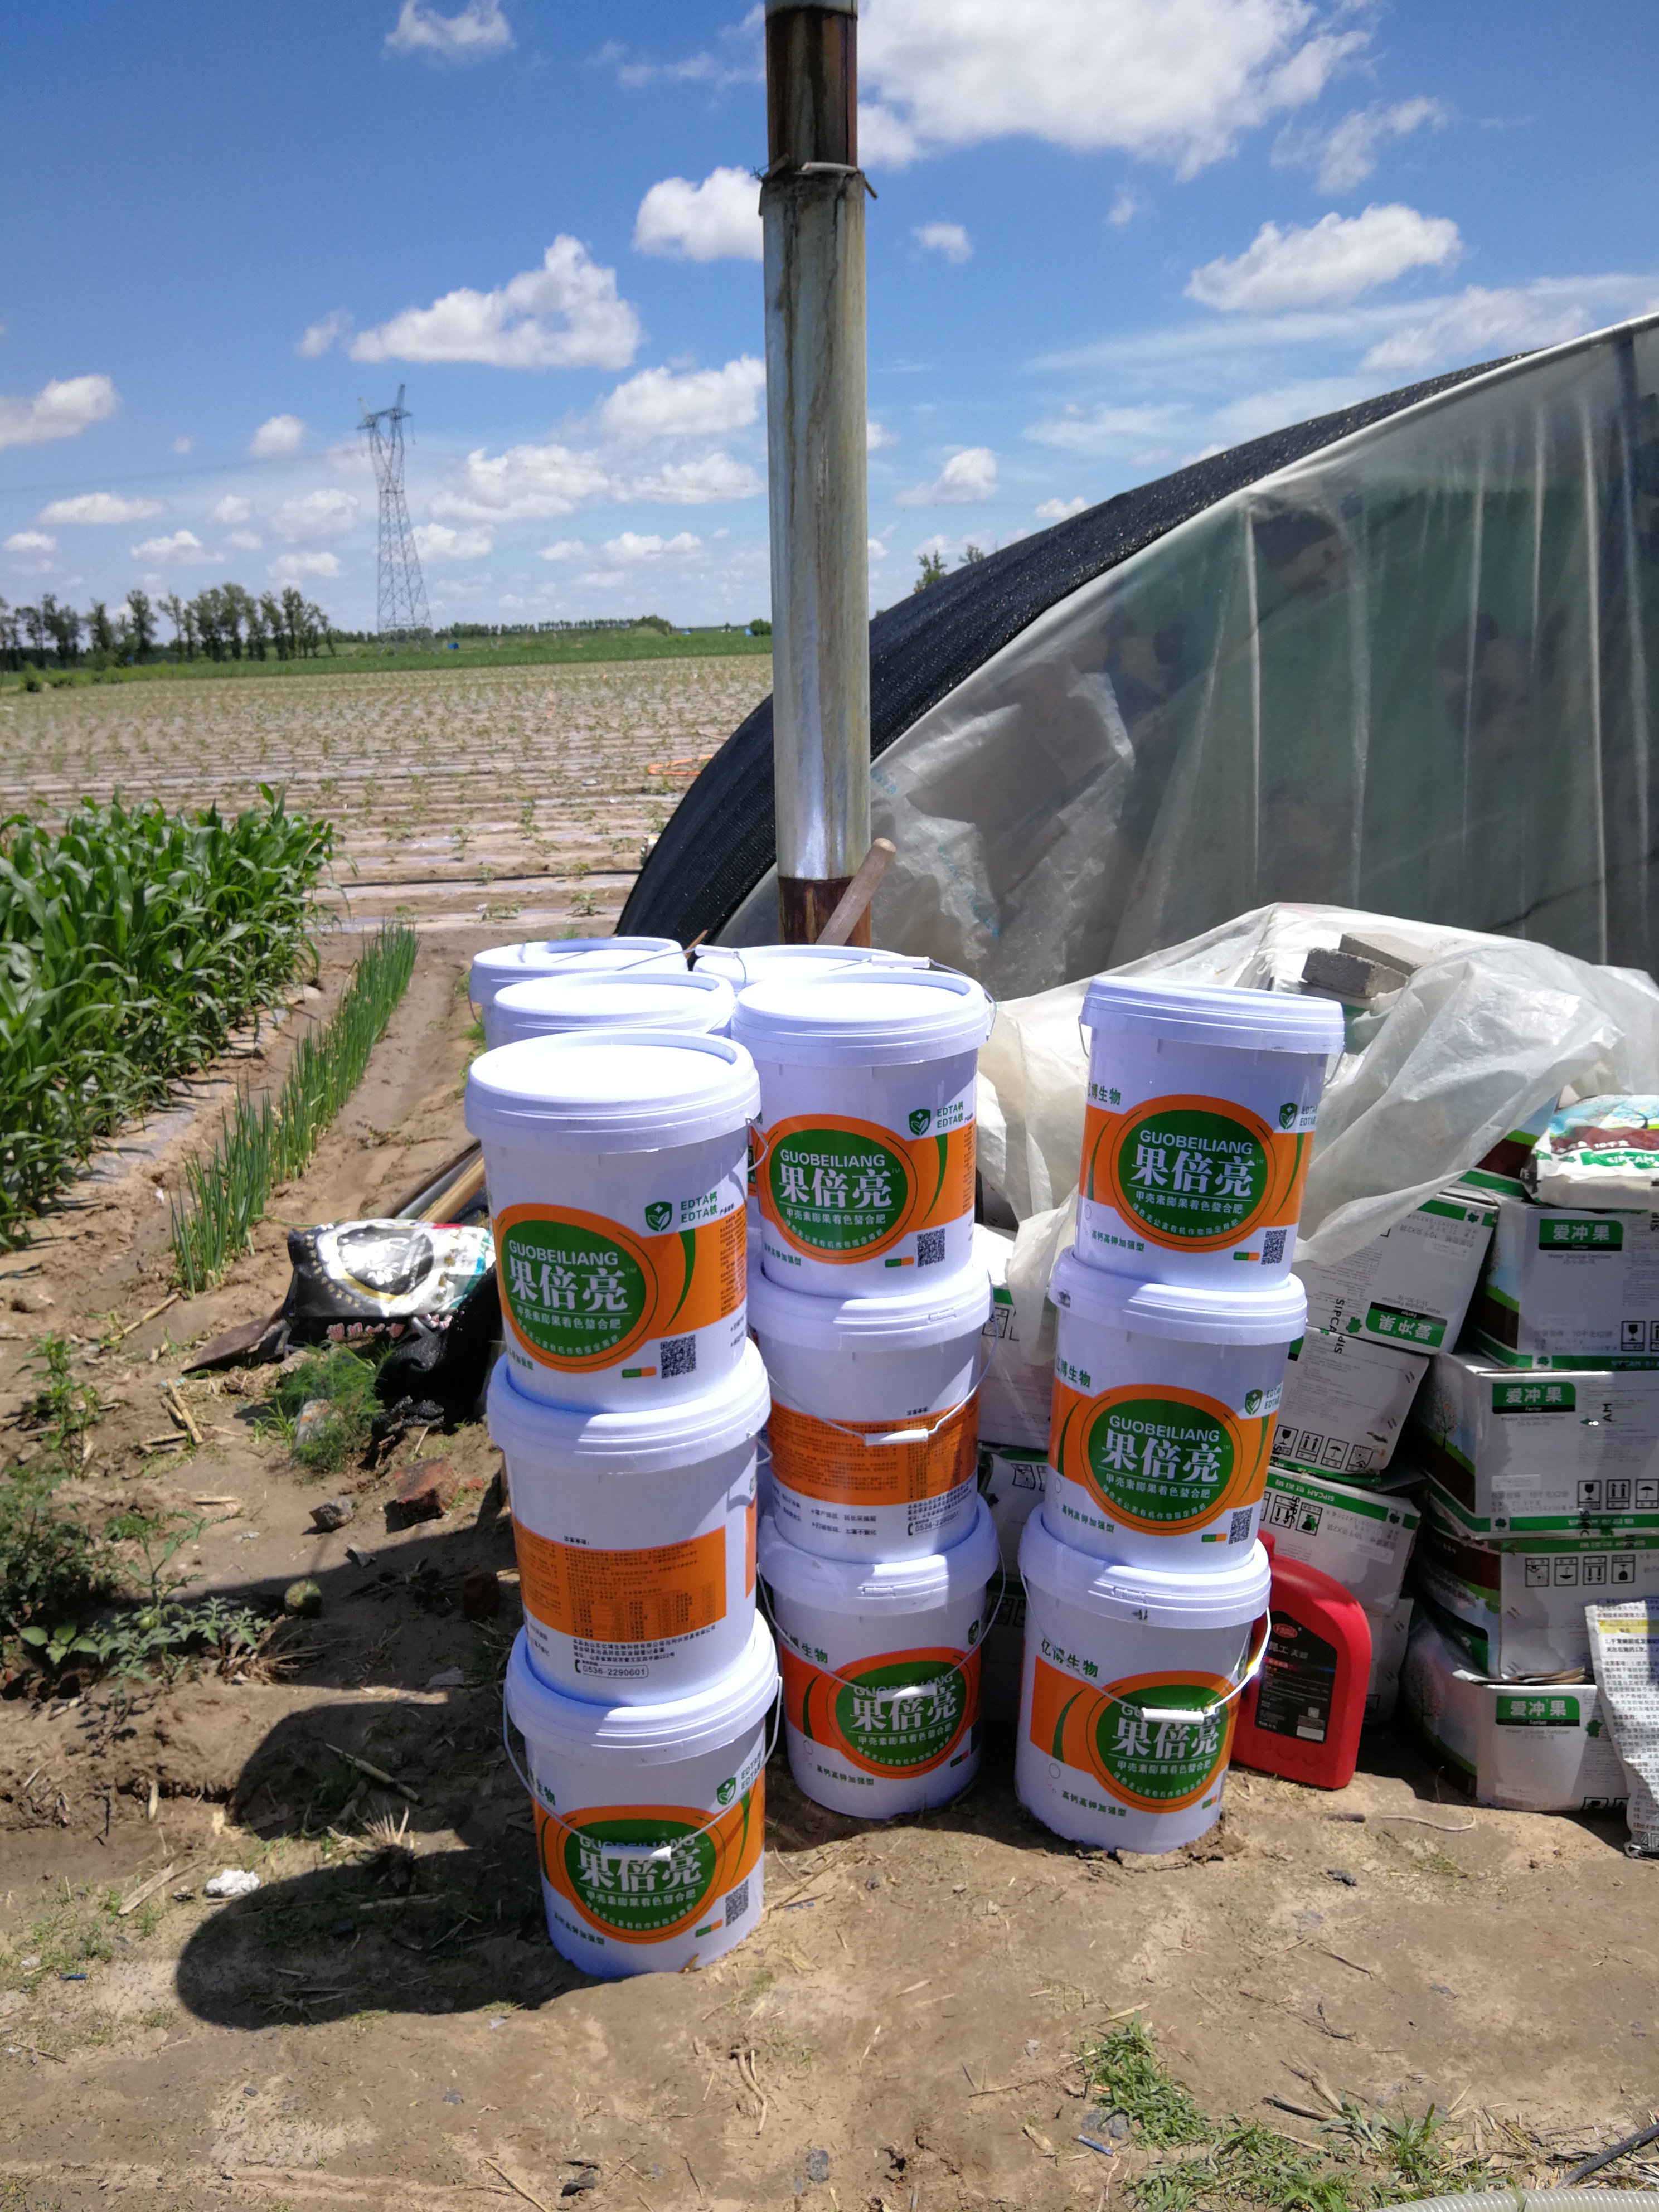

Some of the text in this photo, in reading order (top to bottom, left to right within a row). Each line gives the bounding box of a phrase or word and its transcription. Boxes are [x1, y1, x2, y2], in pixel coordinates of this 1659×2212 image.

[1139, 1129, 1254, 1154] GUOBEILIANG
[780, 1148, 885, 1167] GUOBEILIANG
[1130, 1143, 1256, 1197] 果倍亮
[779, 1162, 892, 1210] 果倍亮
[1553, 1224, 1610, 1241] 爱冲果
[508, 1239, 618, 1265] GUOBEILIANG
[508, 1255, 628, 1312] 果倍亮
[1377, 1313, 1432, 1342] 爱冲果
[1506, 1386, 1563, 1404] 爱冲果
[1109, 1414, 1220, 1443] GUOBEILIANG
[1100, 1428, 1223, 1482] 果倍亮
[849, 1684, 957, 1732] 果倍亮
[1510, 1700, 1566, 1716] 爱冲果
[1107, 1715, 1221, 1759] 果倍亮
[577, 1846, 702, 1893] 果倍亮
